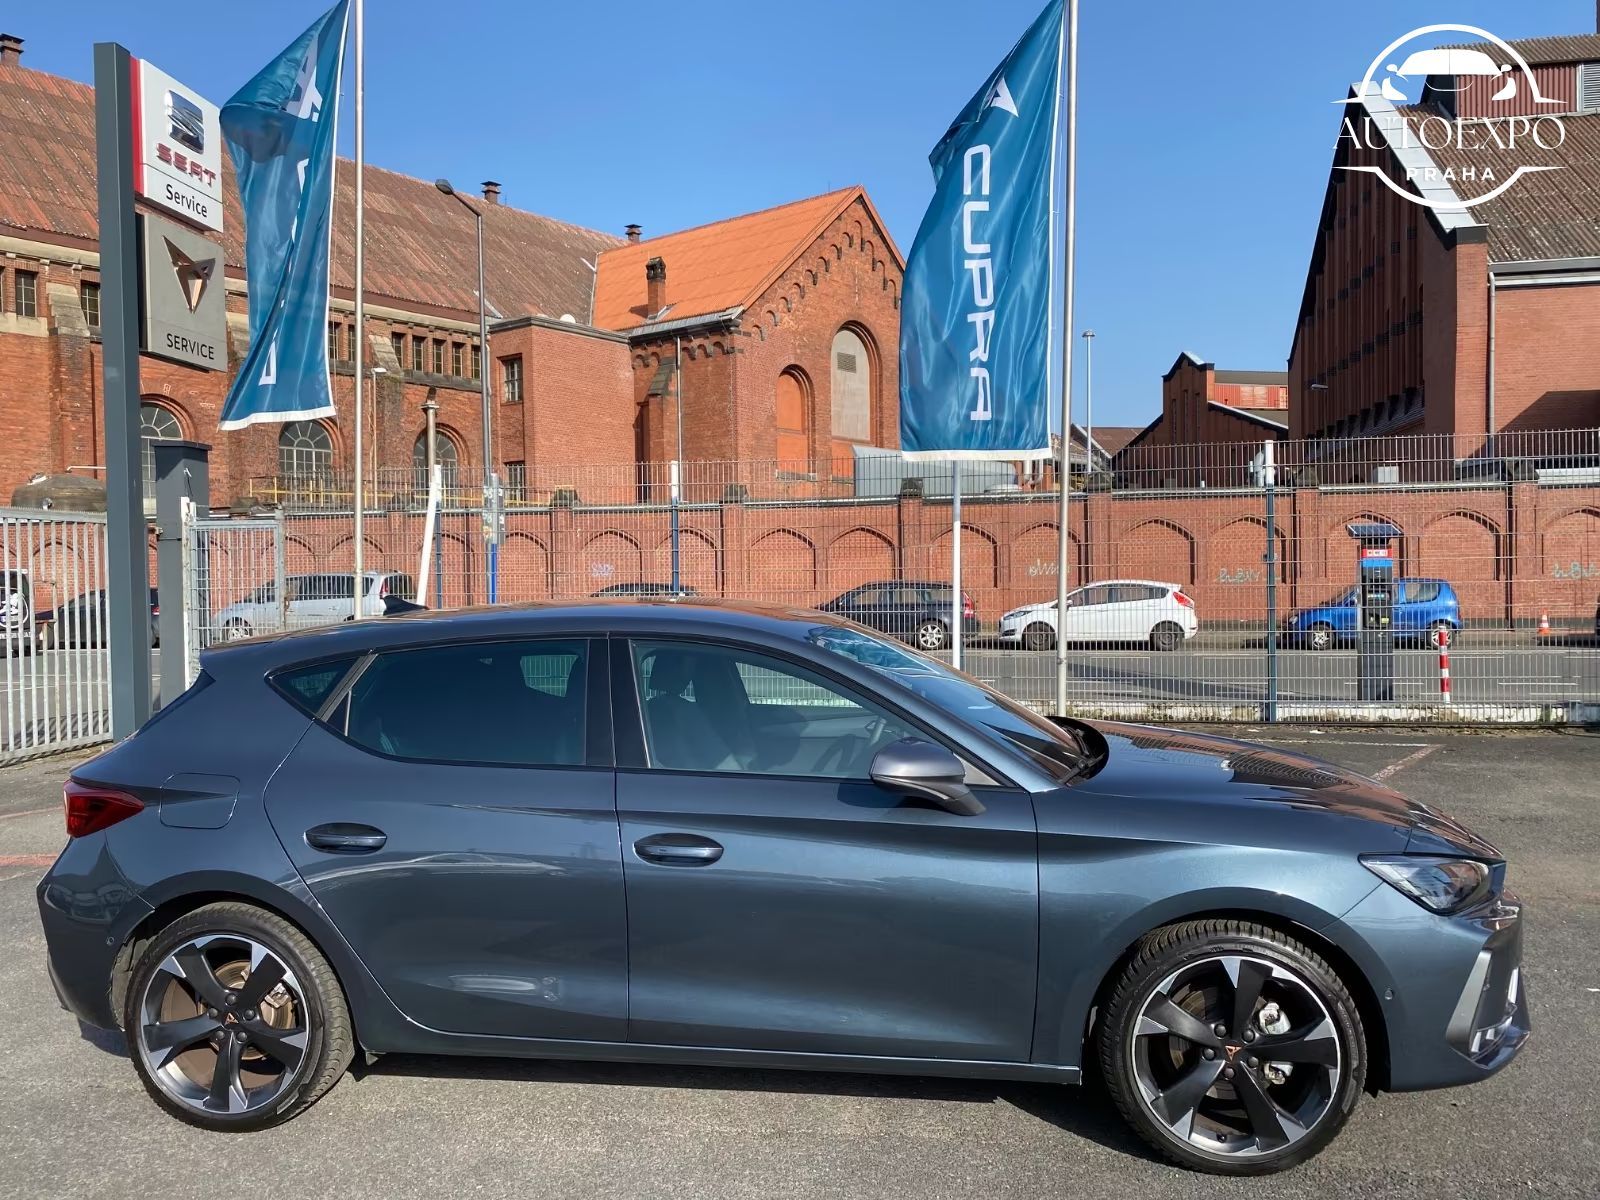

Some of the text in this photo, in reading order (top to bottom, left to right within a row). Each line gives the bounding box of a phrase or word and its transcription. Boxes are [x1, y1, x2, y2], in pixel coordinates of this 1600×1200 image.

[156, 142, 217, 187] SEAT
[165, 183, 208, 218] Service
[962, 143, 995, 421] CUPRA
[166, 333, 215, 360] SERVICE
